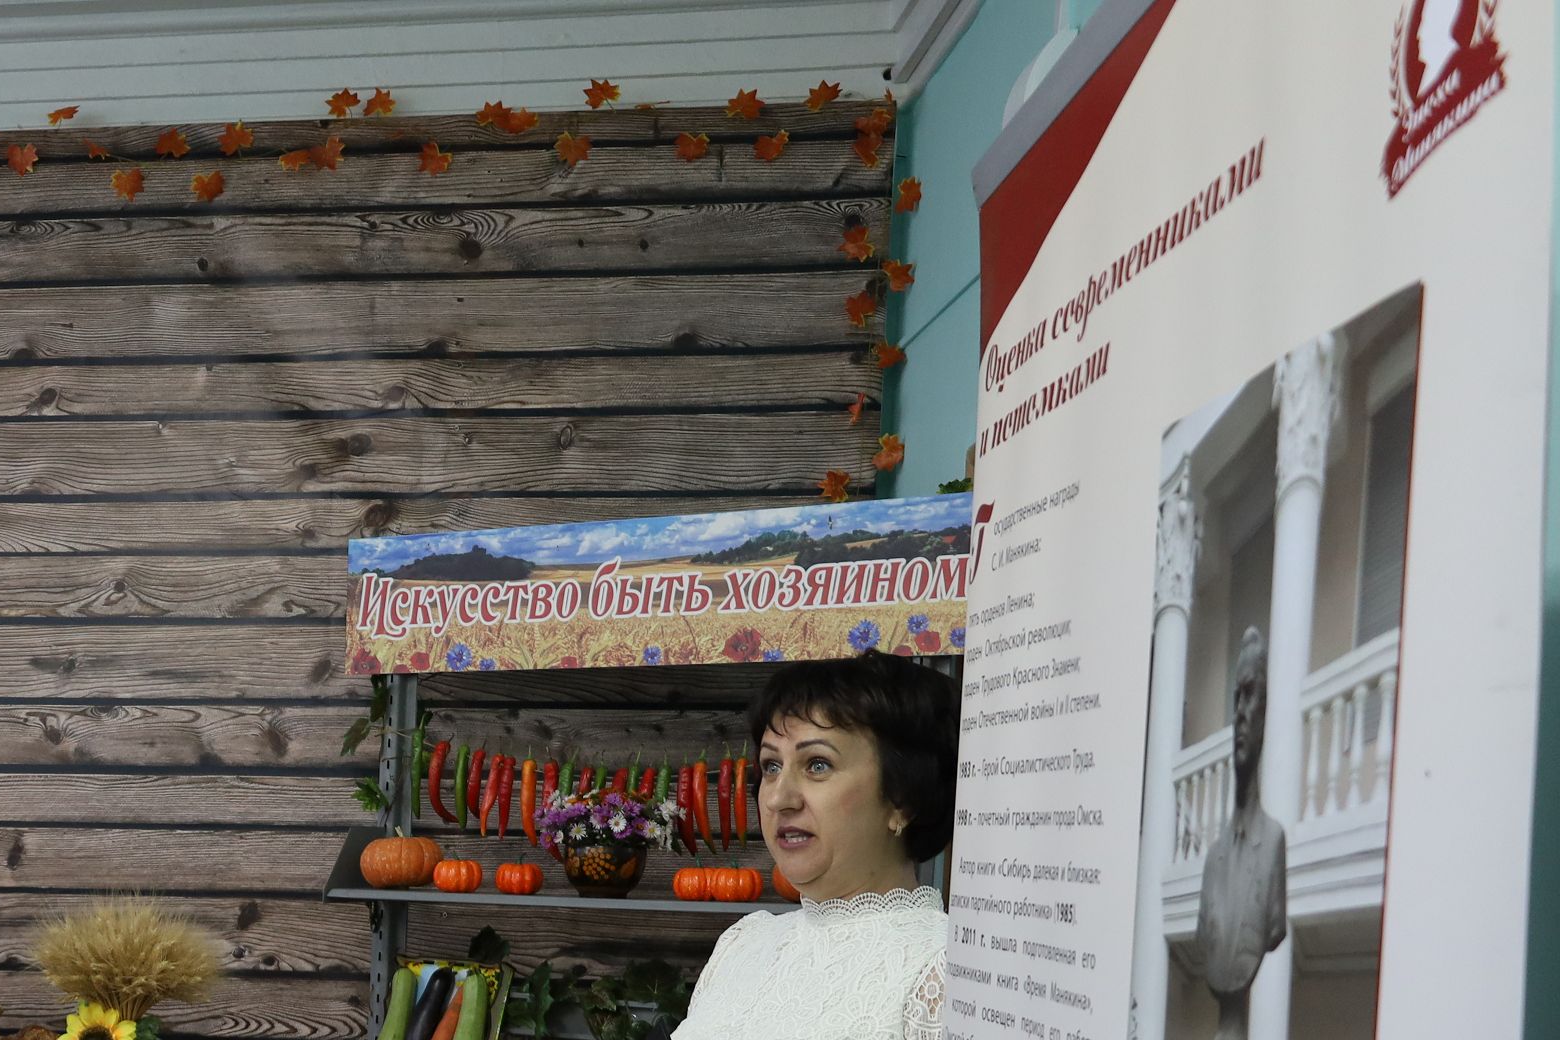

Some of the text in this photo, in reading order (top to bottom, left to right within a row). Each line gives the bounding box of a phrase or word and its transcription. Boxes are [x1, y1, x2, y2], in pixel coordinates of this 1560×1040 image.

[985, 136, 1265, 393] Оценка современниками
[979, 341, 1111, 458] и потомками
[358, 557, 967, 637] Искусство быть хозяином
[984, 628, 1026, 656] Октябрьской
[981, 673, 1011, 697] Трудового
[1013, 664, 1049, 690] Красного
[978, 702, 1029, 729] Отечественной
[1031, 699, 1054, 721] войны
[1000, 754, 1072, 779] Социалистического
[1011, 810, 1052, 830] гражданин
[1053, 810, 1076, 830] города
[1076, 805, 1104, 827] Омска.
[958, 857, 976, 880] Автор
[977, 861, 996, 877] книги
[1033, 864, 1060, 883] далекая
[1060, 867, 1066, 882] и
[970, 894, 1011, 915] партийного
[961, 926, 976, 945] 2011
[980, 933, 986, 948] г.
[990, 935, 1017, 953] вышла
[1022, 939, 1077, 966] подготовленная
[1081, 951, 1097, 970] его
[946, 961, 992, 985] подвижниками
[996, 973, 1019, 992] книга
[952, 997, 977, 1020] которой
[981, 1006, 1015, 1029] освещен
[1021, 1016, 1044, 1039] период
